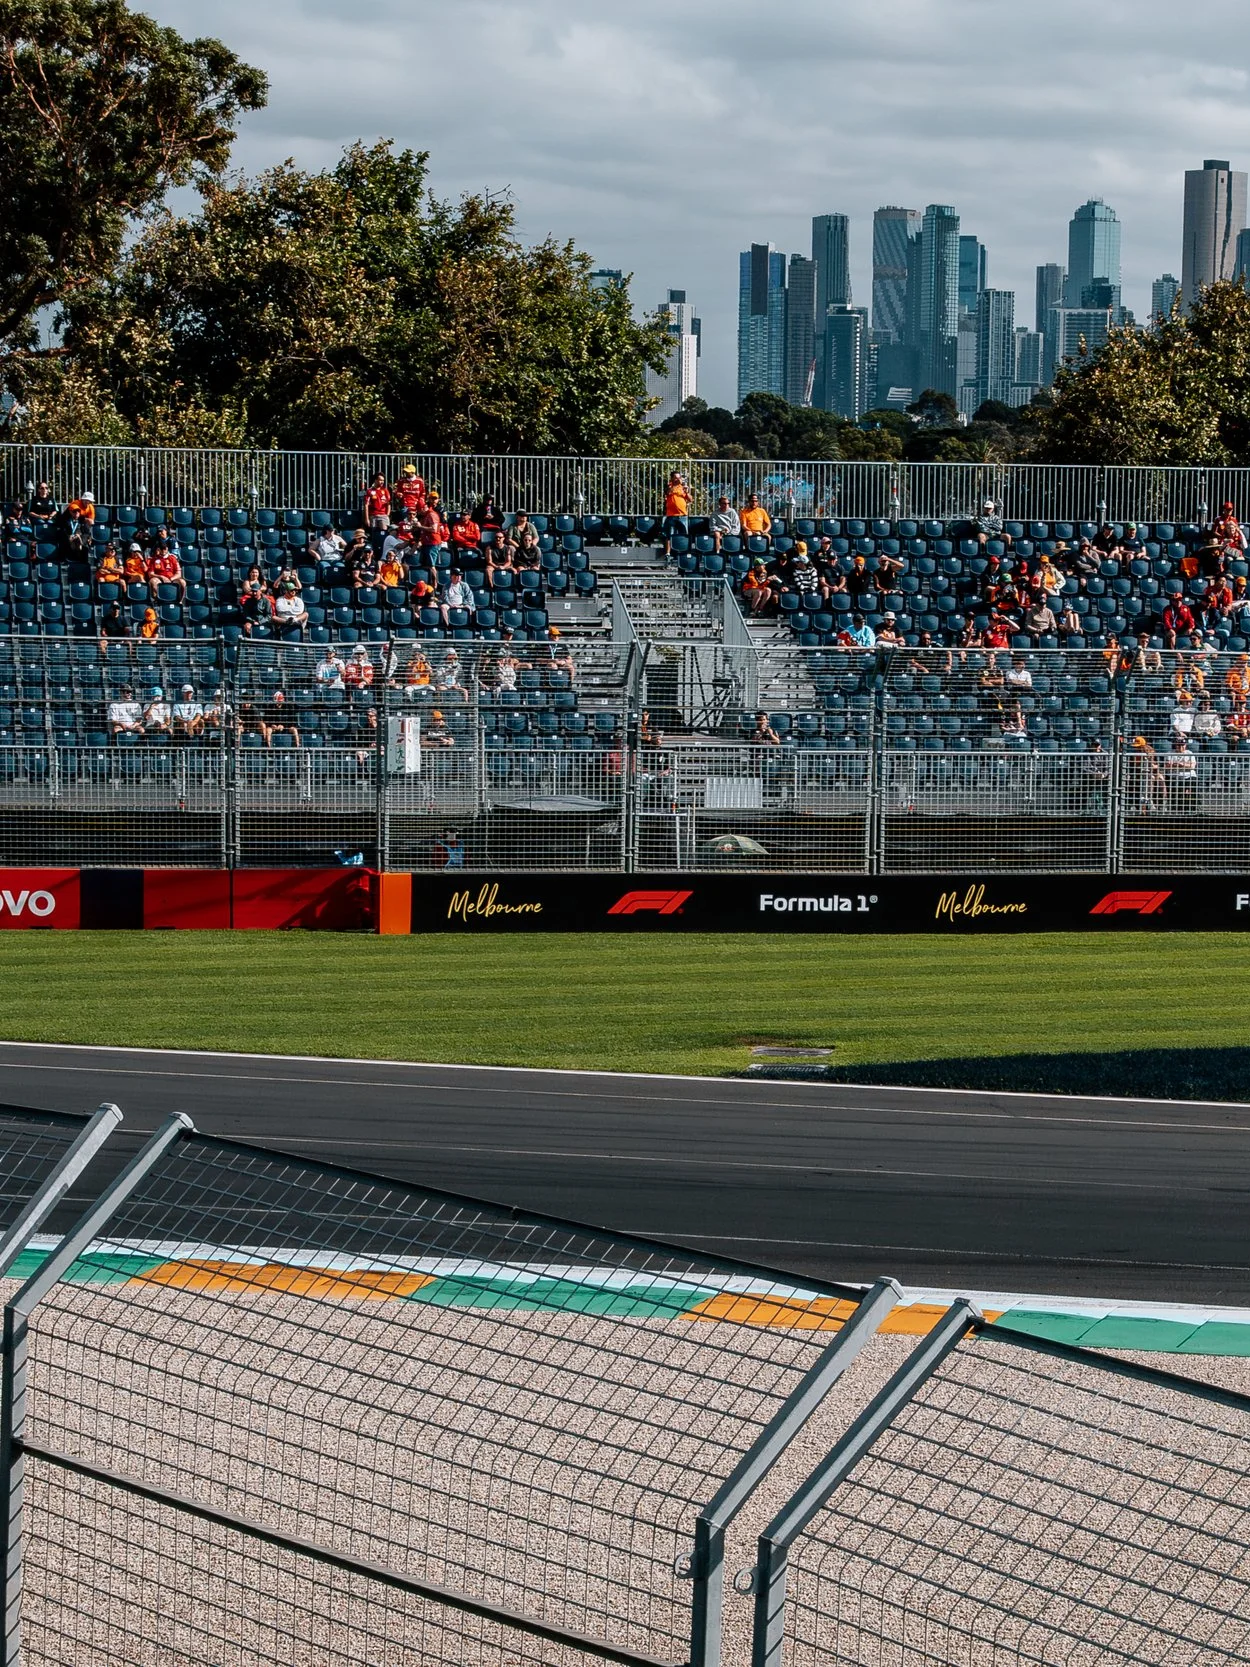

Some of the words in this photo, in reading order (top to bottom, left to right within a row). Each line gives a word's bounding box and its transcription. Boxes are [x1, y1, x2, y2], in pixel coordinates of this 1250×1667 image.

[0, 890, 56, 917] VO
[447, 882, 543, 921] Melbourne
[759, 894, 852, 912] Formula
[935, 884, 1028, 922] Melbourne
